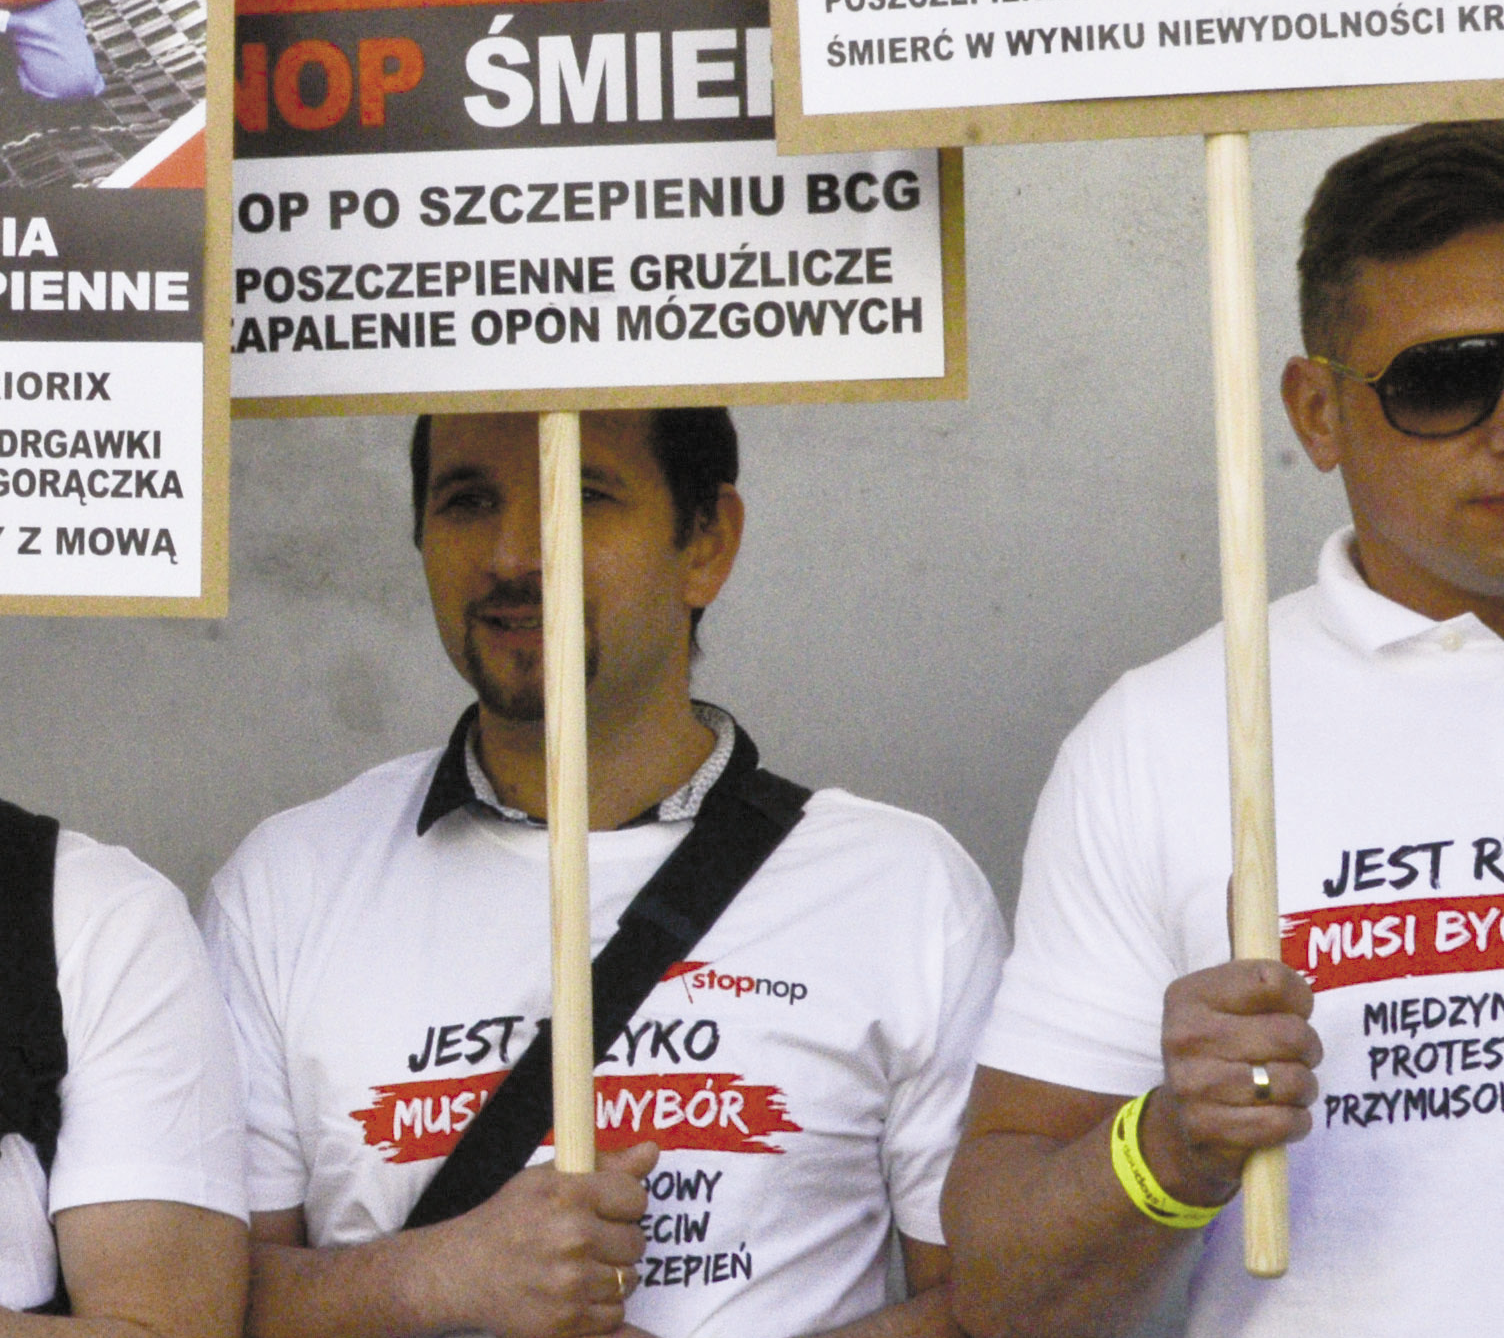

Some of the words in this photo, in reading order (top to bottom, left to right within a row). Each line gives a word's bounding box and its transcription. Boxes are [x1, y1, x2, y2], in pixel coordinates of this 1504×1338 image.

[826, 28, 955, 69] ŚMIERĆ
[967, 29, 997, 59] W
[1007, 20, 1147, 57] WYNIKU
[1158, 1, 1444, 48] NIEWYDOLNOŚCI
[238, 192, 309, 233] OP
[329, 187, 400, 230] PO
[420, 174, 785, 229] SZCZEPIENIU
[806, 170, 922, 215] BCG
[236, 256, 615, 305] POSZCZEPIENNE
[629, 242, 893, 291] GRUŹLICZE
[231, 312, 456, 353] APALENIE
[616, 296, 923, 343] MÓZGOWYCH
[18, 526, 42, 555] Z
[55, 526, 178, 564] MOWĄ
[1322, 840, 1455, 898] JEST
[1307, 915, 1416, 969] MUSI
[692, 968, 808, 1005] stopnop
[408, 1015, 524, 1073] JEST
[597, 1078, 750, 1134] WYBÓR
